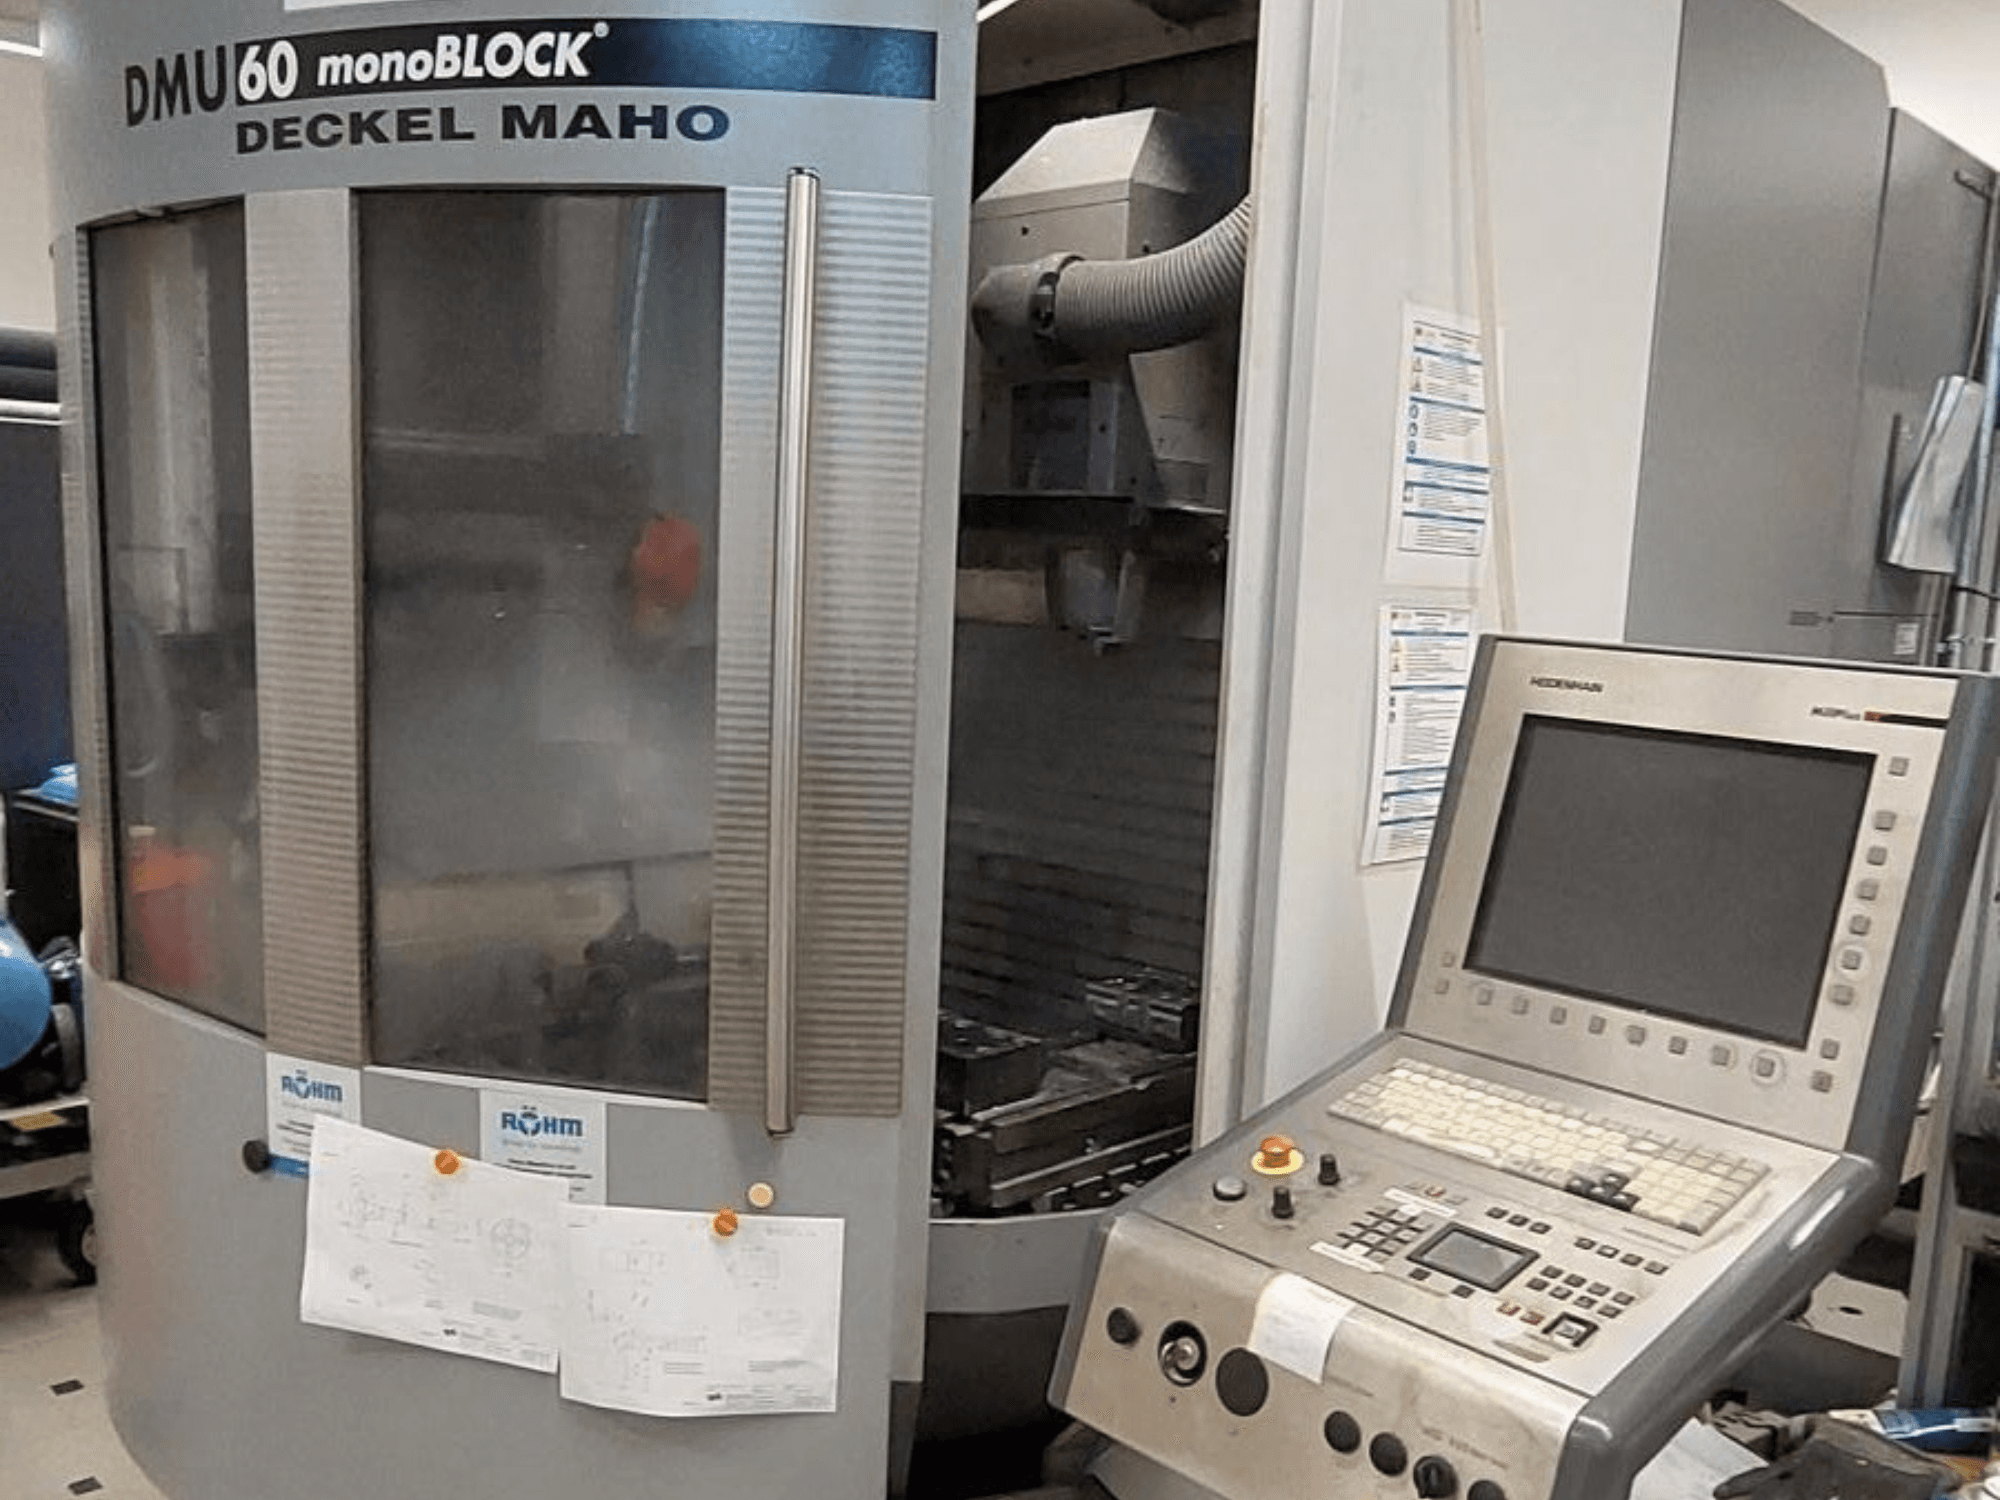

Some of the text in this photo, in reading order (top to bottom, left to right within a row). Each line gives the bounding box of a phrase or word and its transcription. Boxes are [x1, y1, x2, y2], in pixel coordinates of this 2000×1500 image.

[125, 45, 227, 127] DMU
[238, 40, 298, 101] 60
[236, 104, 730, 154] DECKEL MAHO
